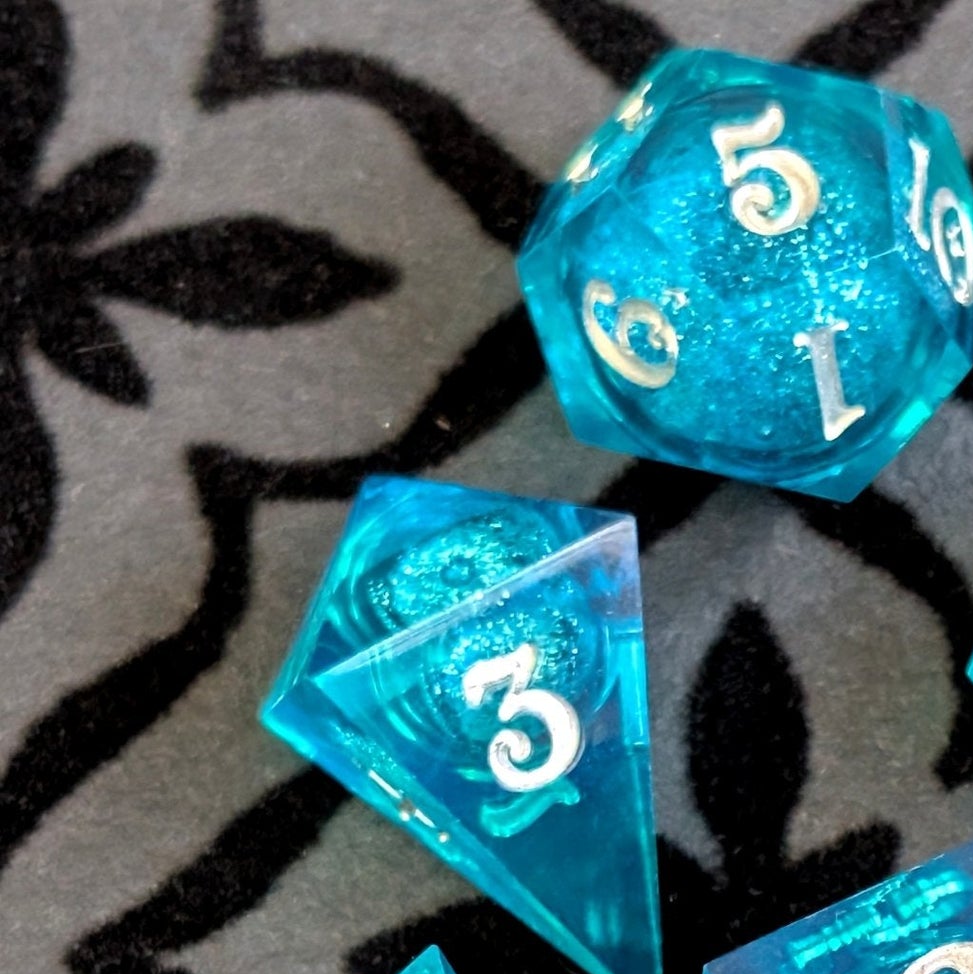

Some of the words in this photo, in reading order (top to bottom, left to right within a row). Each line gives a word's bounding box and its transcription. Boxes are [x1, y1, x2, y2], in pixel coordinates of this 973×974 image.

[711, 101, 822, 237] 5
[793, 320, 867, 442] 1
[462, 642, 585, 792] 3
